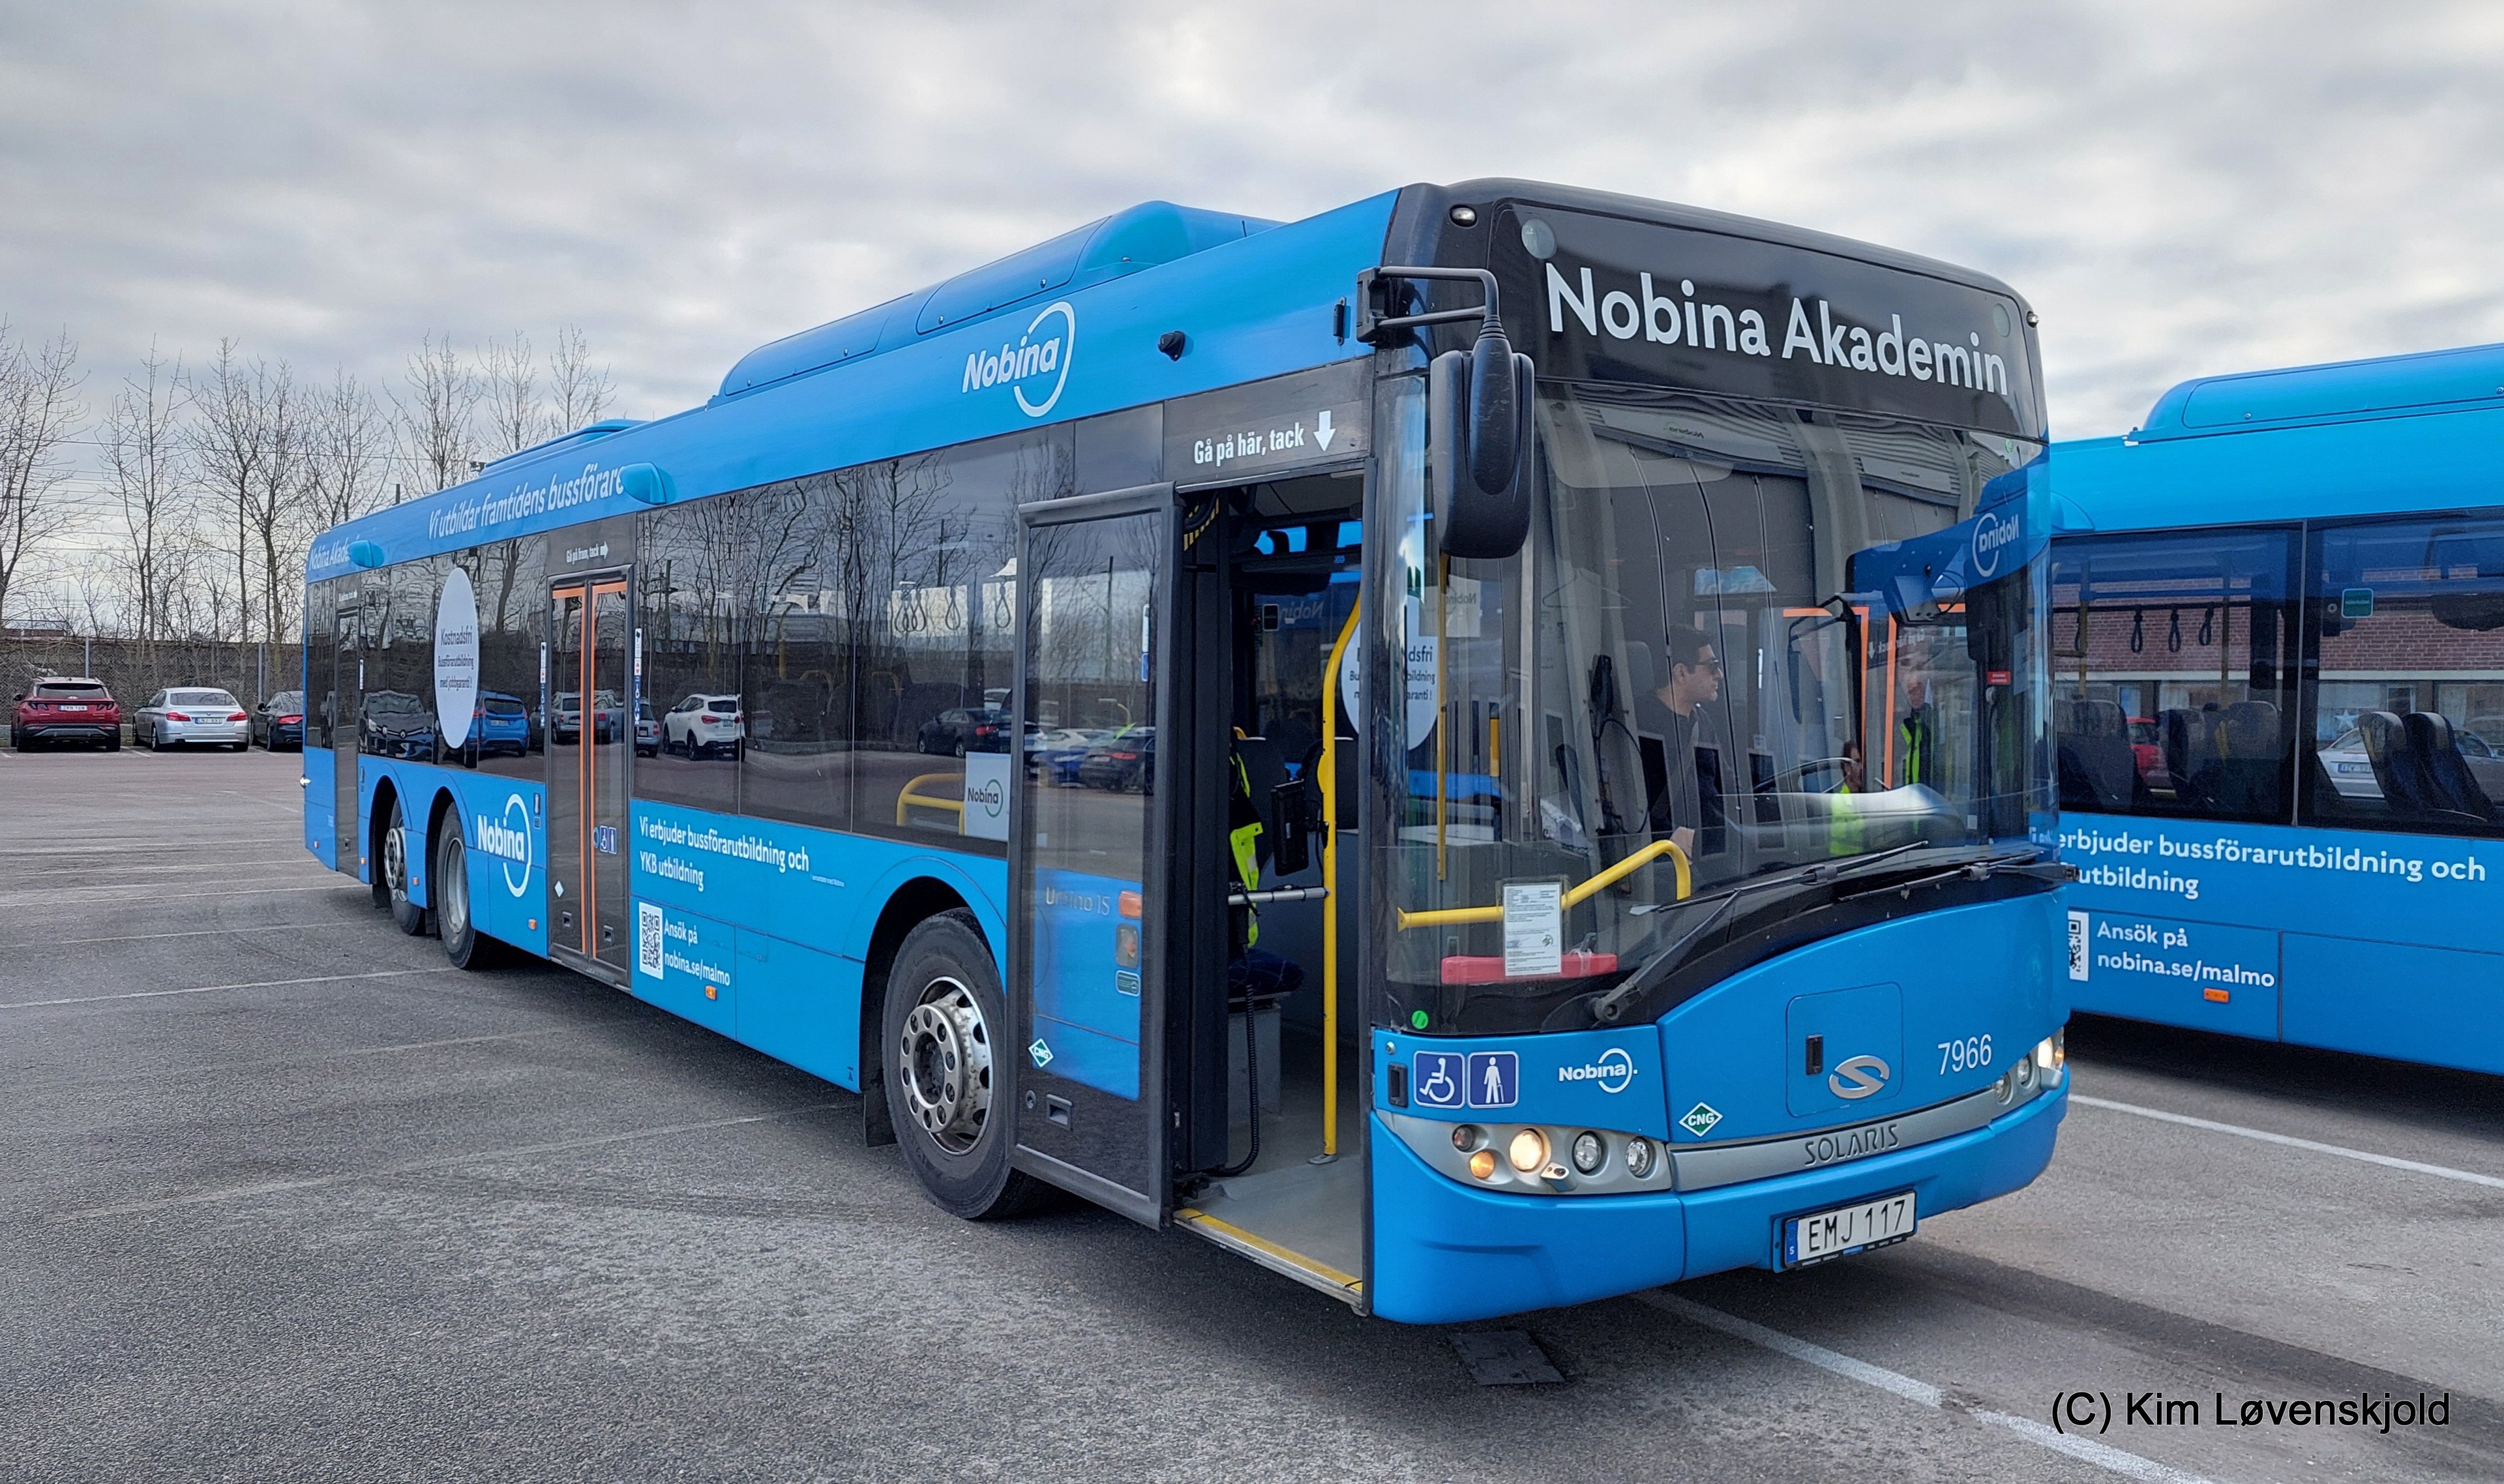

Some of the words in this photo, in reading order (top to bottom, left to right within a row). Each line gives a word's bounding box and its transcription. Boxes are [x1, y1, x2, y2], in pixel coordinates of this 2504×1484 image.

[1546, 262, 1771, 357] Nobina
[1781, 297, 2008, 396] Akademin
[962, 335, 1060, 393] Nobina
[1194, 438, 1213, 464] Gå
[1216, 434, 1234, 467] på
[1238, 431, 1266, 457] här,
[1270, 422, 1304, 451] tack
[428, 508, 440, 540] Vi
[439, 498, 481, 538] utbildar
[480, 482, 546, 527] framtidens
[441, 625, 472, 646] Kostnadsfri
[968, 787, 998, 804] Nobina
[477, 814, 524, 861] Nobina
[640, 816, 648, 837] Vi
[649, 818, 686, 846] erbjuder
[688, 824, 785, 874] bussförarutbildning
[788, 846, 809, 872] och
[640, 850, 657, 874] YKB
[659, 856, 704, 892] utbildning
[2160, 834, 2422, 882] bussförarutbildning
[2431, 856, 2486, 882] och
[2078, 866, 2199, 900] utbildning
[1097, 895, 1110, 915] 15
[664, 917, 687, 941] Ansök
[688, 925, 698, 947] på
[2097, 921, 2157, 945] Ansök
[2163, 927, 2188, 949] på
[664, 949, 731, 987] nobina.se/malmo
[2097, 951, 2275, 987] nobina.se/malmo
[1034, 1046, 1049, 1060] CNG
[1937, 1033, 1992, 1076] 7966
[1688, 1112, 1715, 1127] CNG
[1804, 1123, 1899, 1166] SOLARIS
[1809, 1211, 1853, 1253] EMJ
[1865, 1199, 1905, 1238] 117
[1789, 1246, 1795, 1255] S
